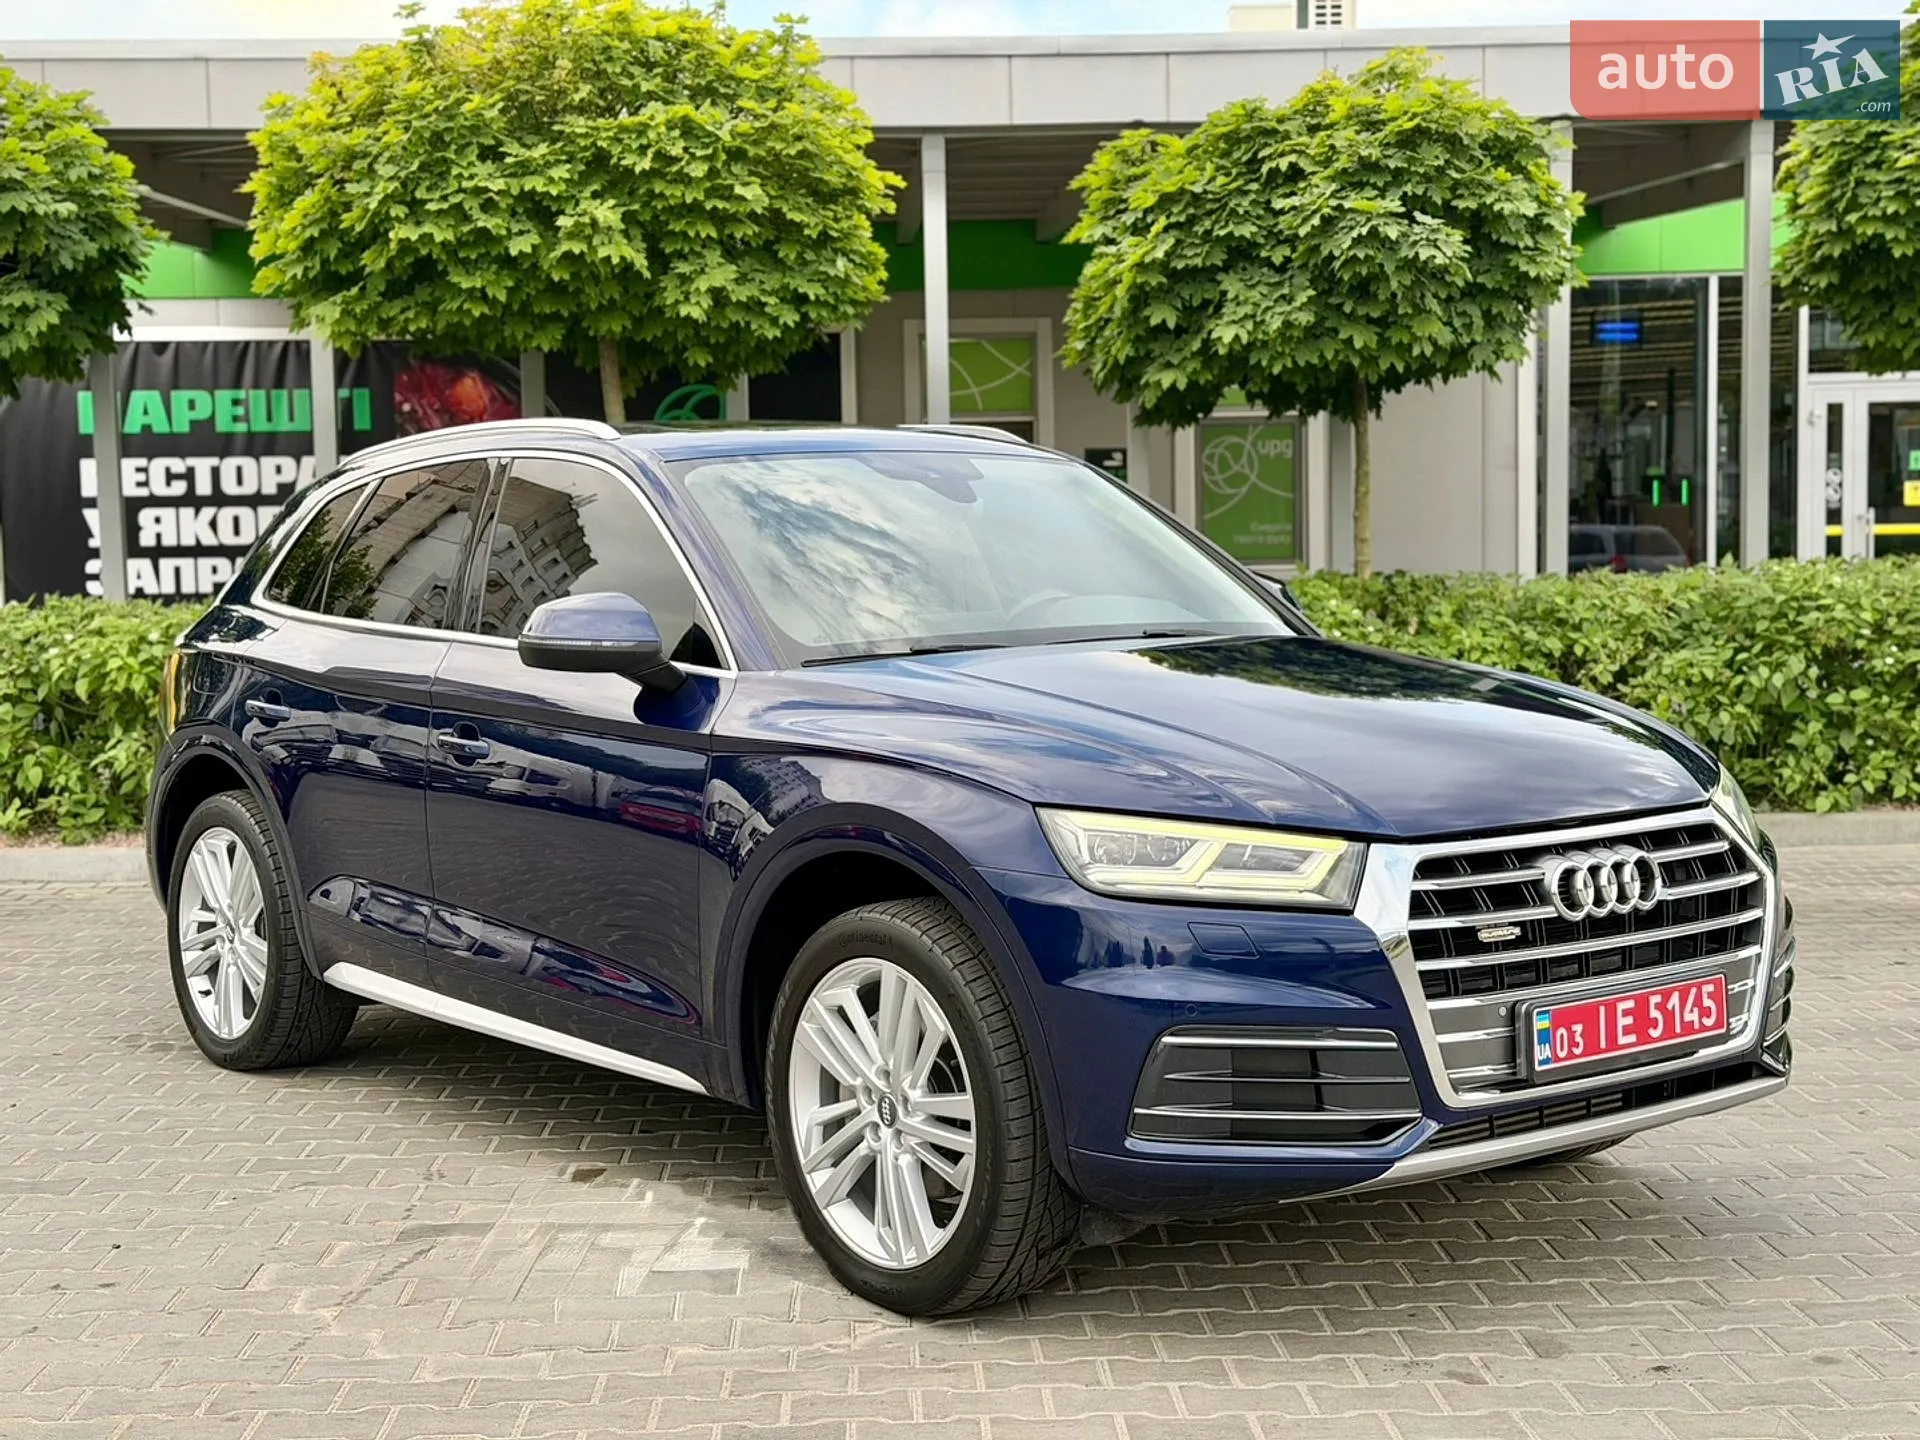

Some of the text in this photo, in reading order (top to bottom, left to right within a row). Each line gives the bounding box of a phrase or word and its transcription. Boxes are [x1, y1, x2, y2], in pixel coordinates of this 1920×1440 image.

[77, 388, 371, 434] АРЕШІ
[1256, 439, 1293, 459] upg
[1555, 1023, 1584, 1059] 03
[1647, 983, 1718, 1039] 5145
[1537, 1043, 1552, 1061] UA
